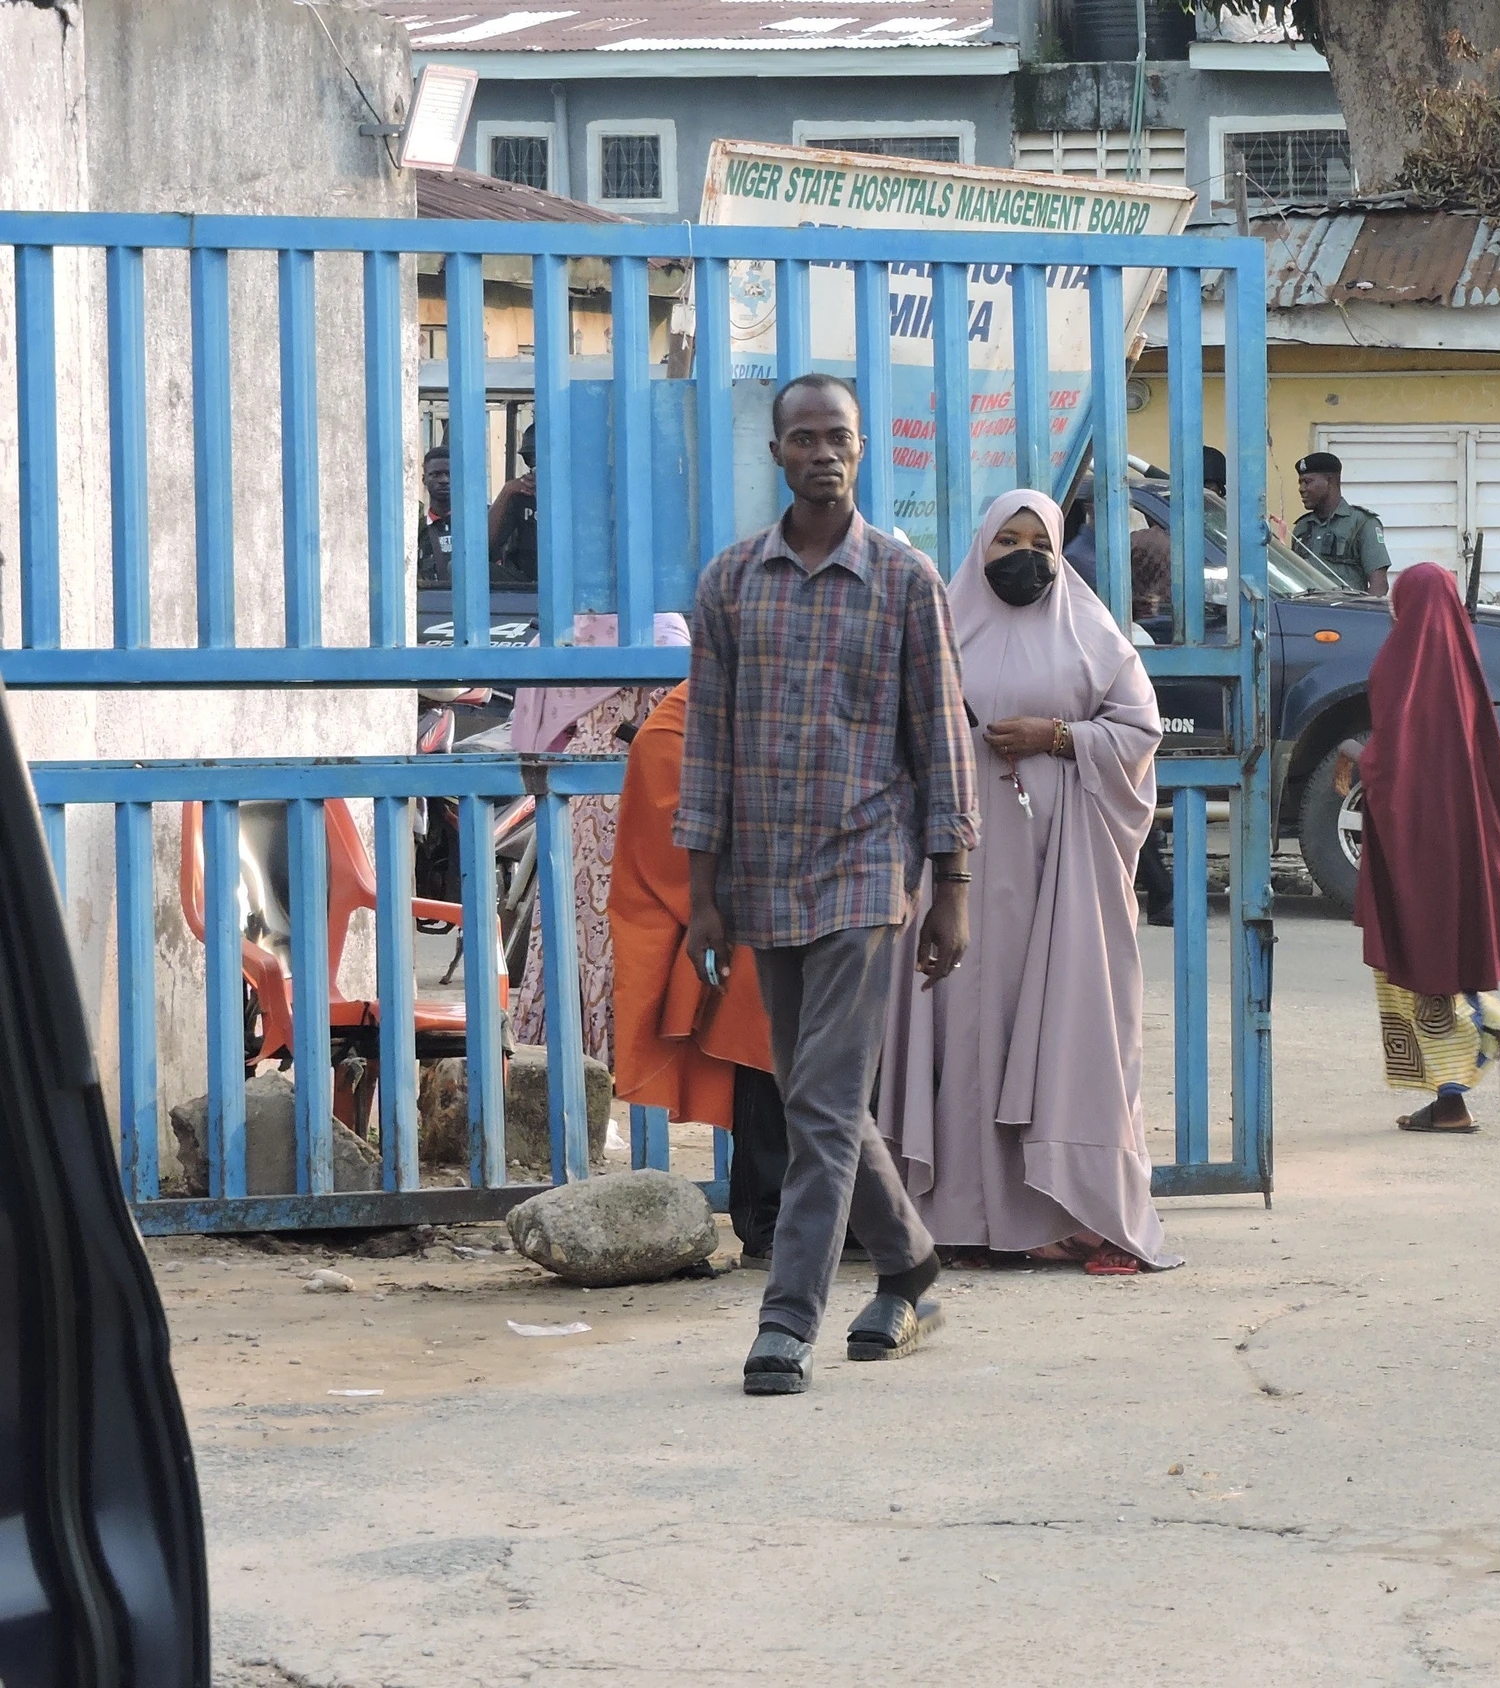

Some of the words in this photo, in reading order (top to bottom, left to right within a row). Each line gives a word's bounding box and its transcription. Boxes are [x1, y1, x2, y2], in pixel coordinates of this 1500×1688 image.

[724, 158, 783, 201] NIGER
[784, 166, 847, 208] STATE
[848, 173, 954, 219] HOSPITALS
[955, 184, 1086, 231] MANAGEMENT
[1088, 198, 1151, 235] BOARD
[889, 292, 993, 342] MIA
[1160, 717, 1194, 733] RON
